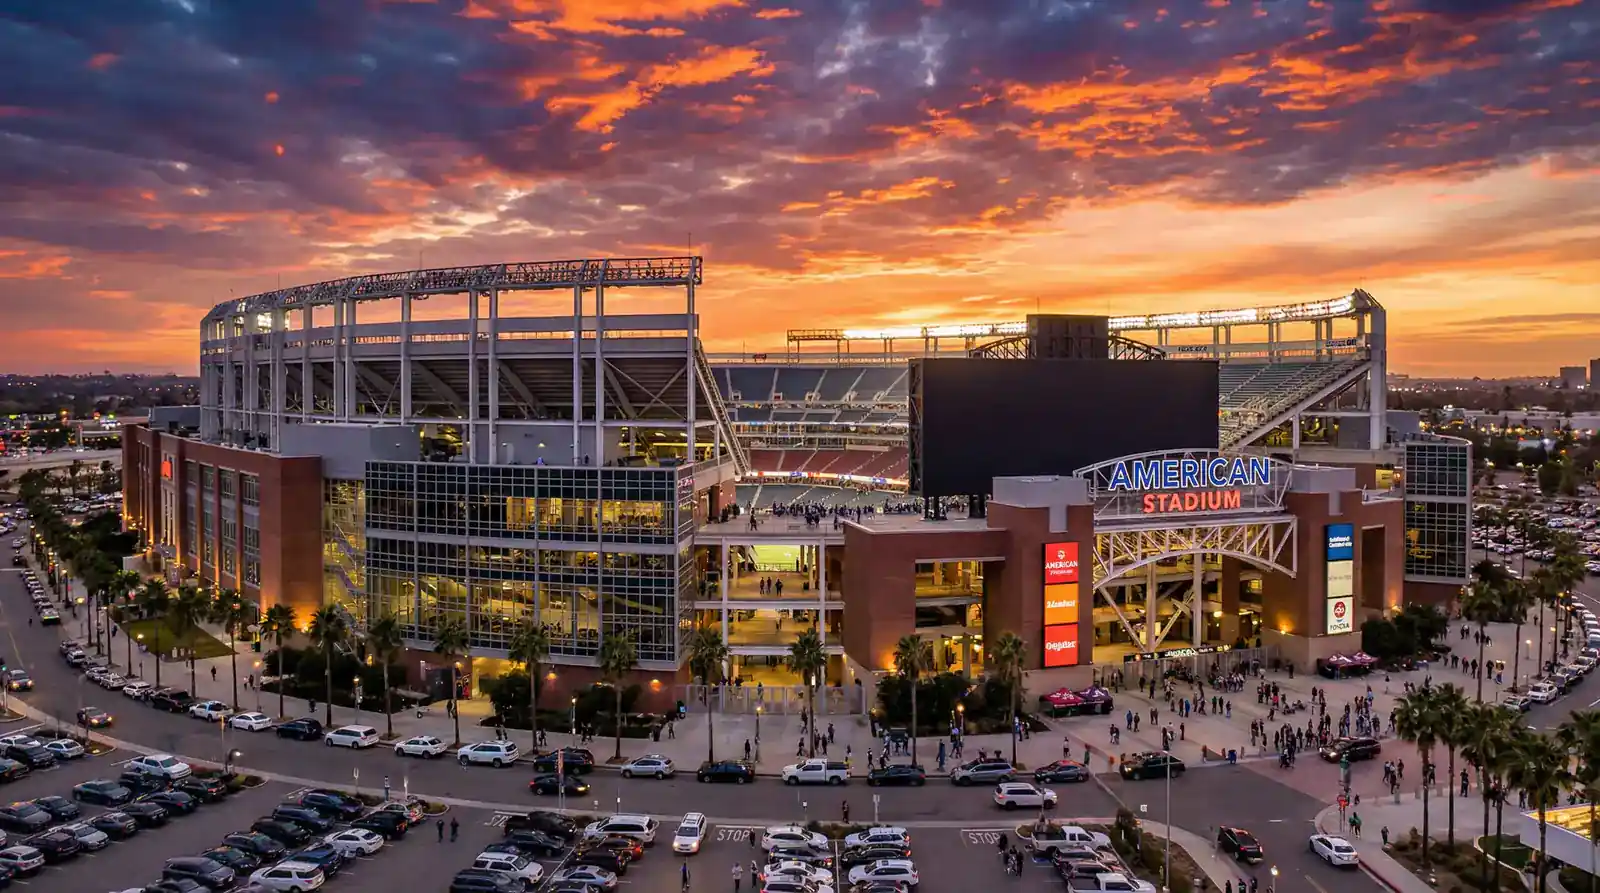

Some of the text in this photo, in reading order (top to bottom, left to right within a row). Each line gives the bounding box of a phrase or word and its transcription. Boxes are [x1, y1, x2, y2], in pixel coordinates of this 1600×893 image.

[1109, 457, 1270, 491] AMERICAN
[1143, 491, 1241, 513] STADIUM
[1045, 561, 1078, 569] AMERICAN
[717, 829, 750, 842] STOP
[968, 832, 1001, 845] STOP
